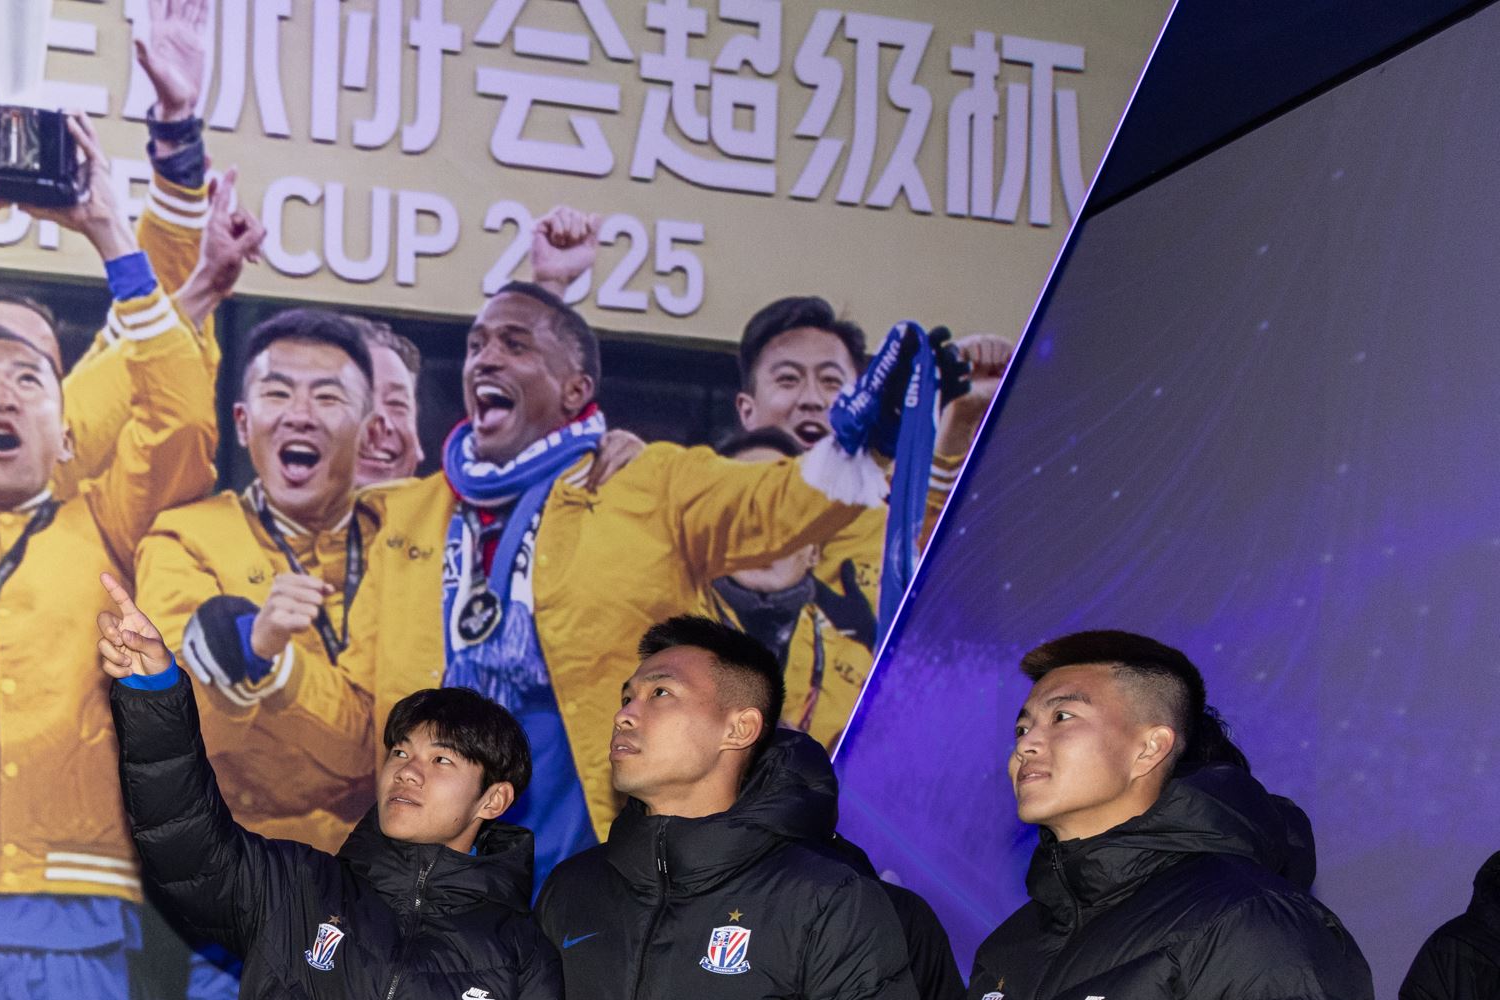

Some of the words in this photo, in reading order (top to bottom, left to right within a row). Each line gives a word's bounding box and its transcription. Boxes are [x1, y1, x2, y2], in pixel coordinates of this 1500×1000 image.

[262, 177, 461, 286] CUP
[482, 200, 705, 318] 225
[466, 986, 490, 999] NIKE
